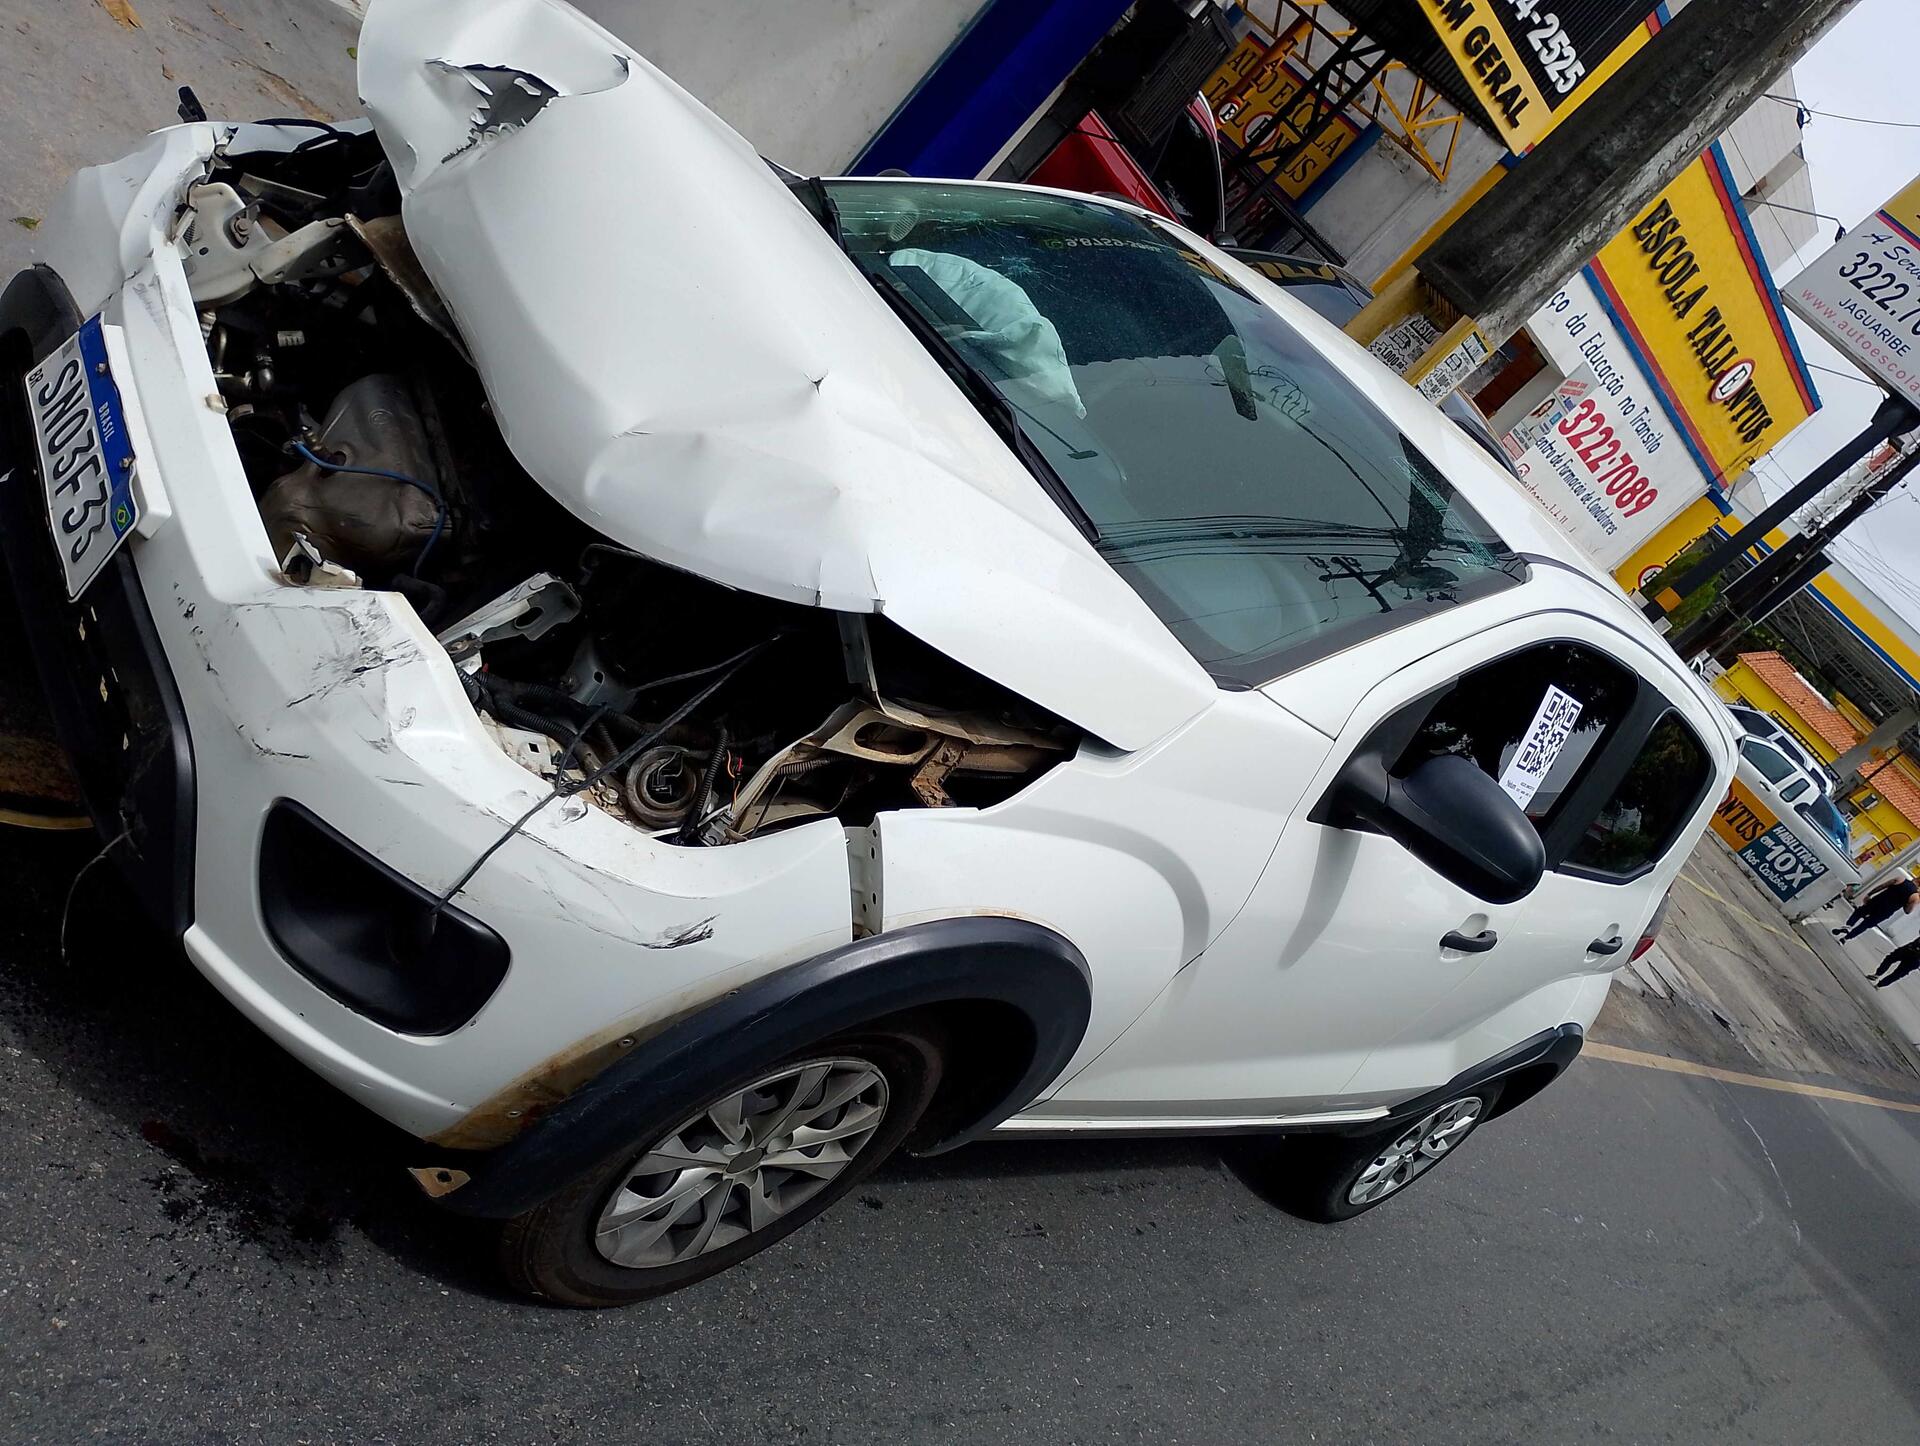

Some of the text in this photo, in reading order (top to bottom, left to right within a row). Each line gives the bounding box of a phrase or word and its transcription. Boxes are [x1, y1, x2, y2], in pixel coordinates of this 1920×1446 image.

[1464, 25, 1529, 129] GERAL
[1861, 233, 1893, 245] A
[1634, 198, 1709, 319] ESCOLA
[1687, 305, 1773, 443] TALLENTUS
[1839, 298, 1911, 357] JAGUARIBE
[28, 368, 43, 389] BR
[1565, 312, 1588, 338] da
[1579, 332, 1624, 397] Educação
[1617, 395, 1636, 416] no
[98, 401, 115, 442] BRASIL
[1550, 452, 1566, 467] de
[1556, 458, 1587, 497] Formação
[1580, 491, 1595, 505] de
[1586, 497, 1618, 535] Condutores
[1742, 848, 1760, 865] Nos
[1760, 835, 1776, 849] em
